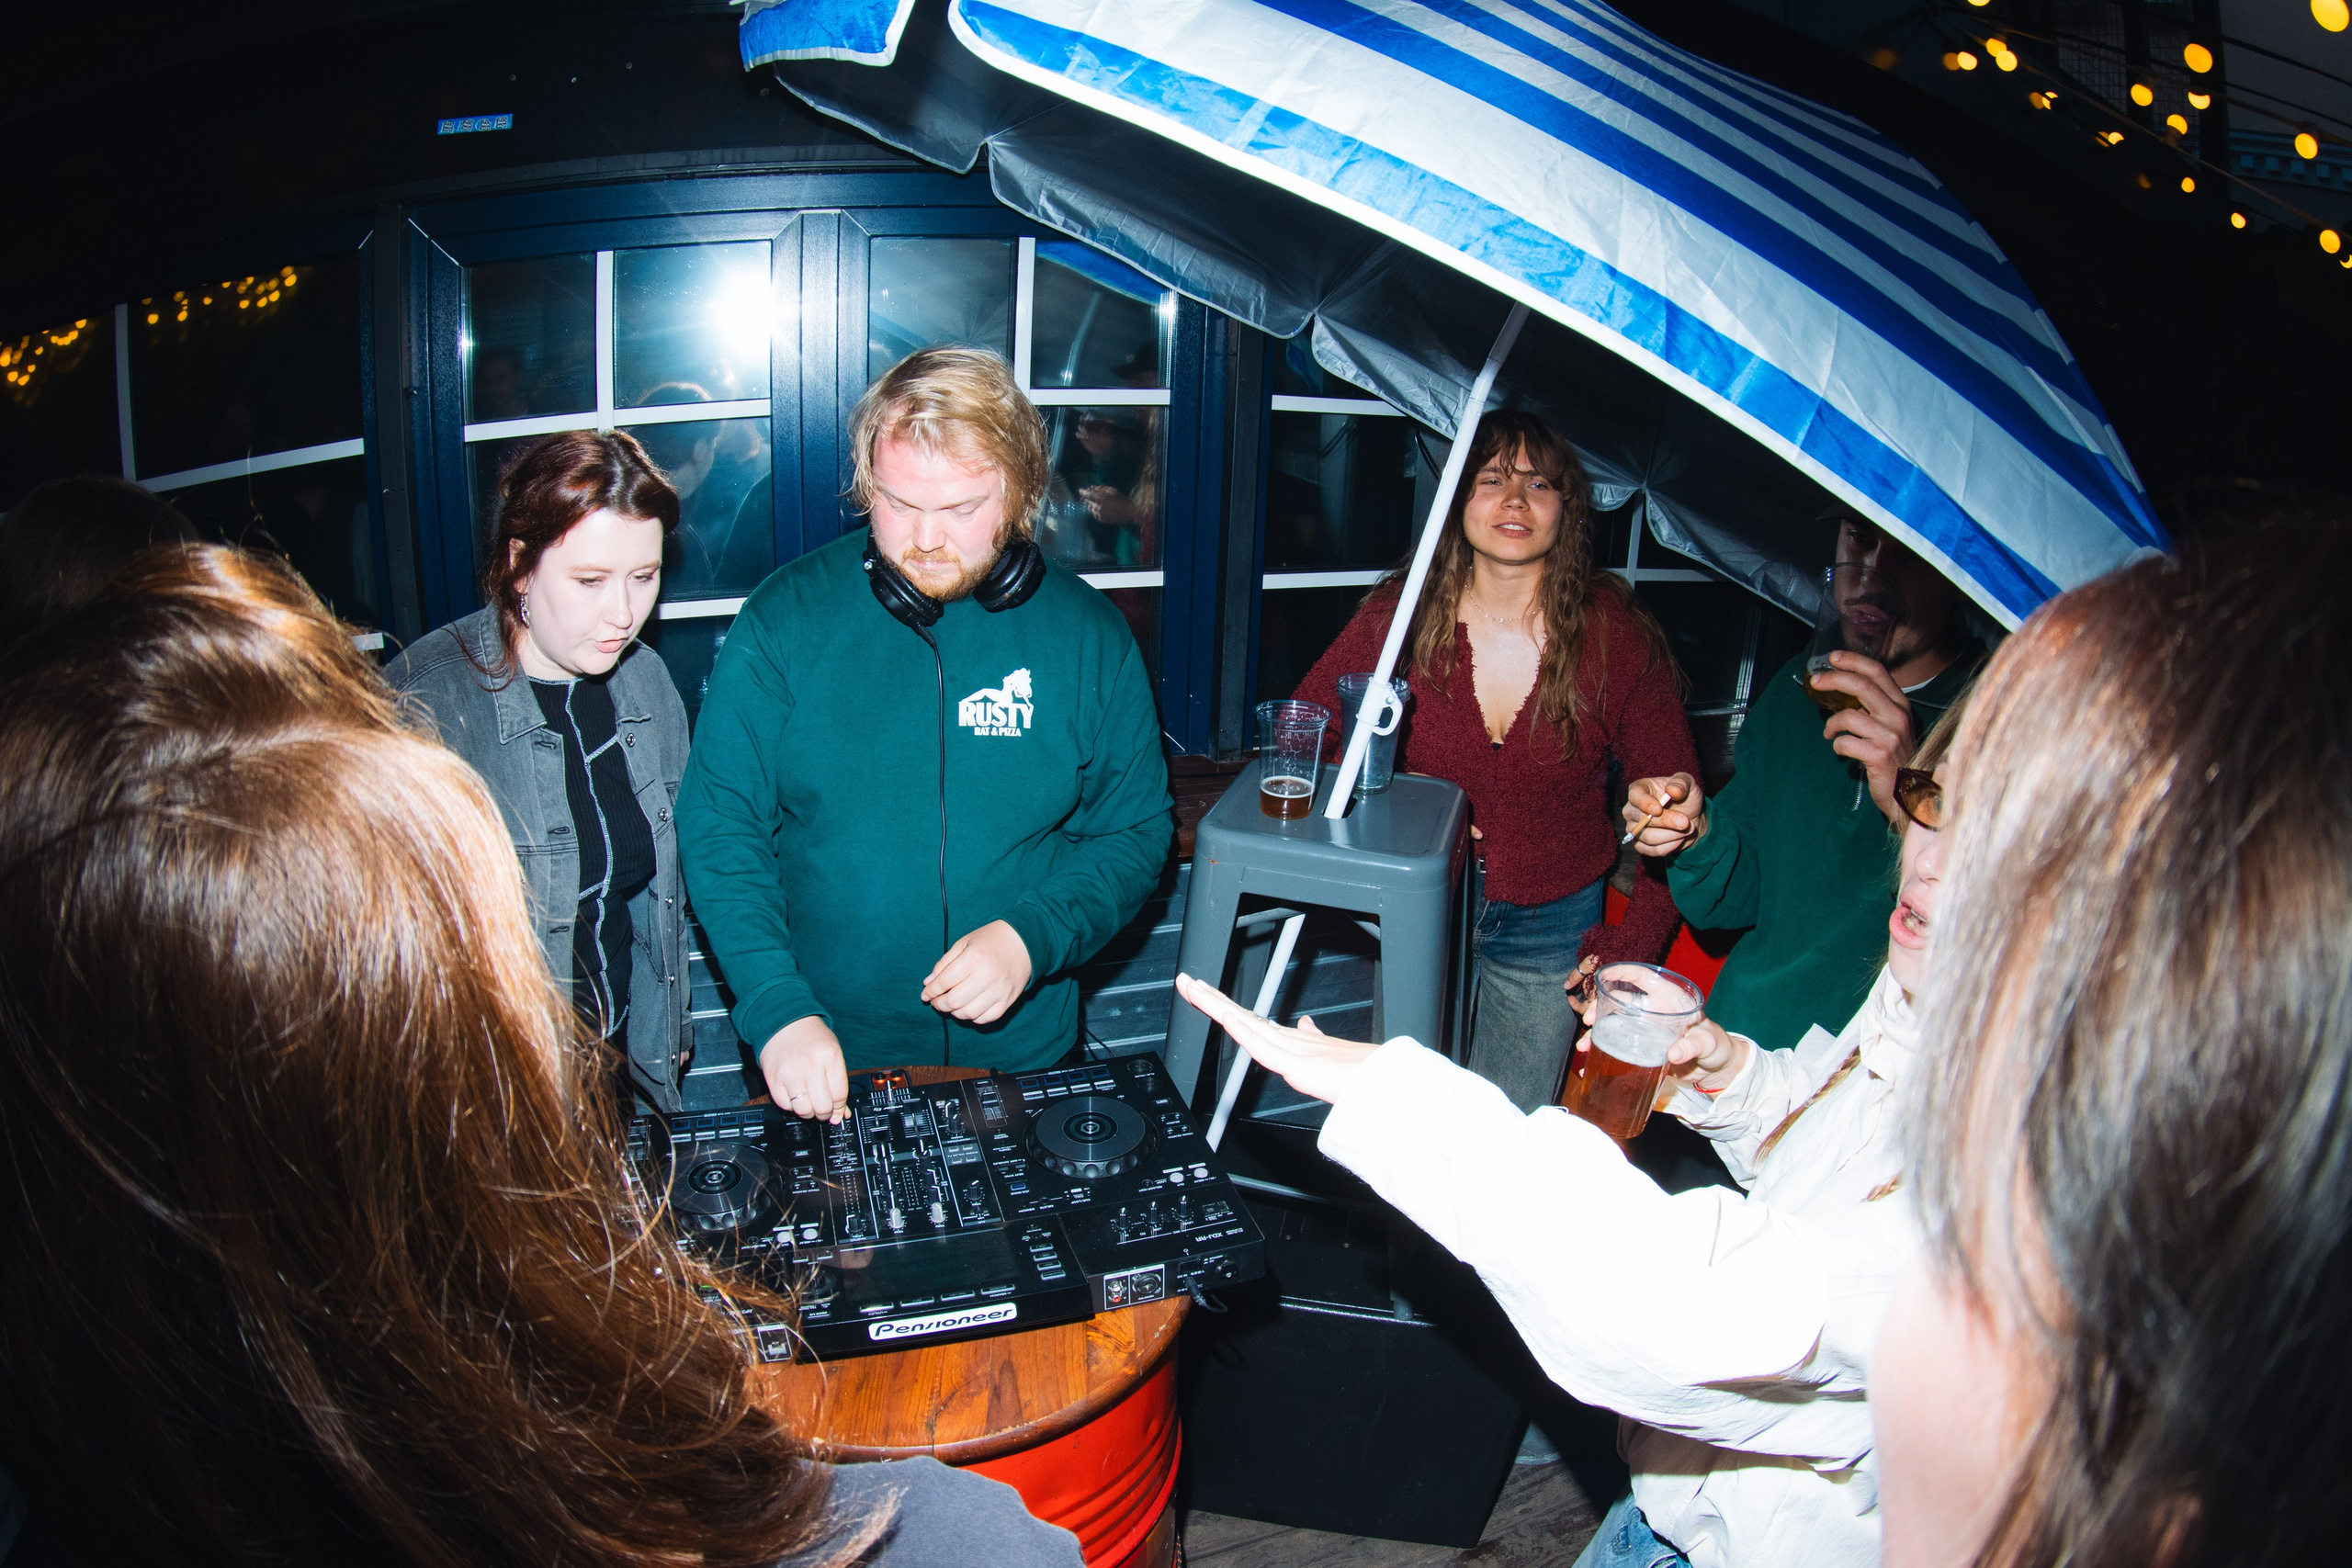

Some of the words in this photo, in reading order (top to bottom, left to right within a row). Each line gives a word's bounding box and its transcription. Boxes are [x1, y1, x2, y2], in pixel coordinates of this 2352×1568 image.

[958, 702, 1034, 728] RUSTY
[990, 727, 998, 736] &
[998, 727, 1022, 737] PIZZA
[1195, 1232, 1224, 1243] XDJ-RR
[875, 1308, 1012, 1337] Pensioneer
